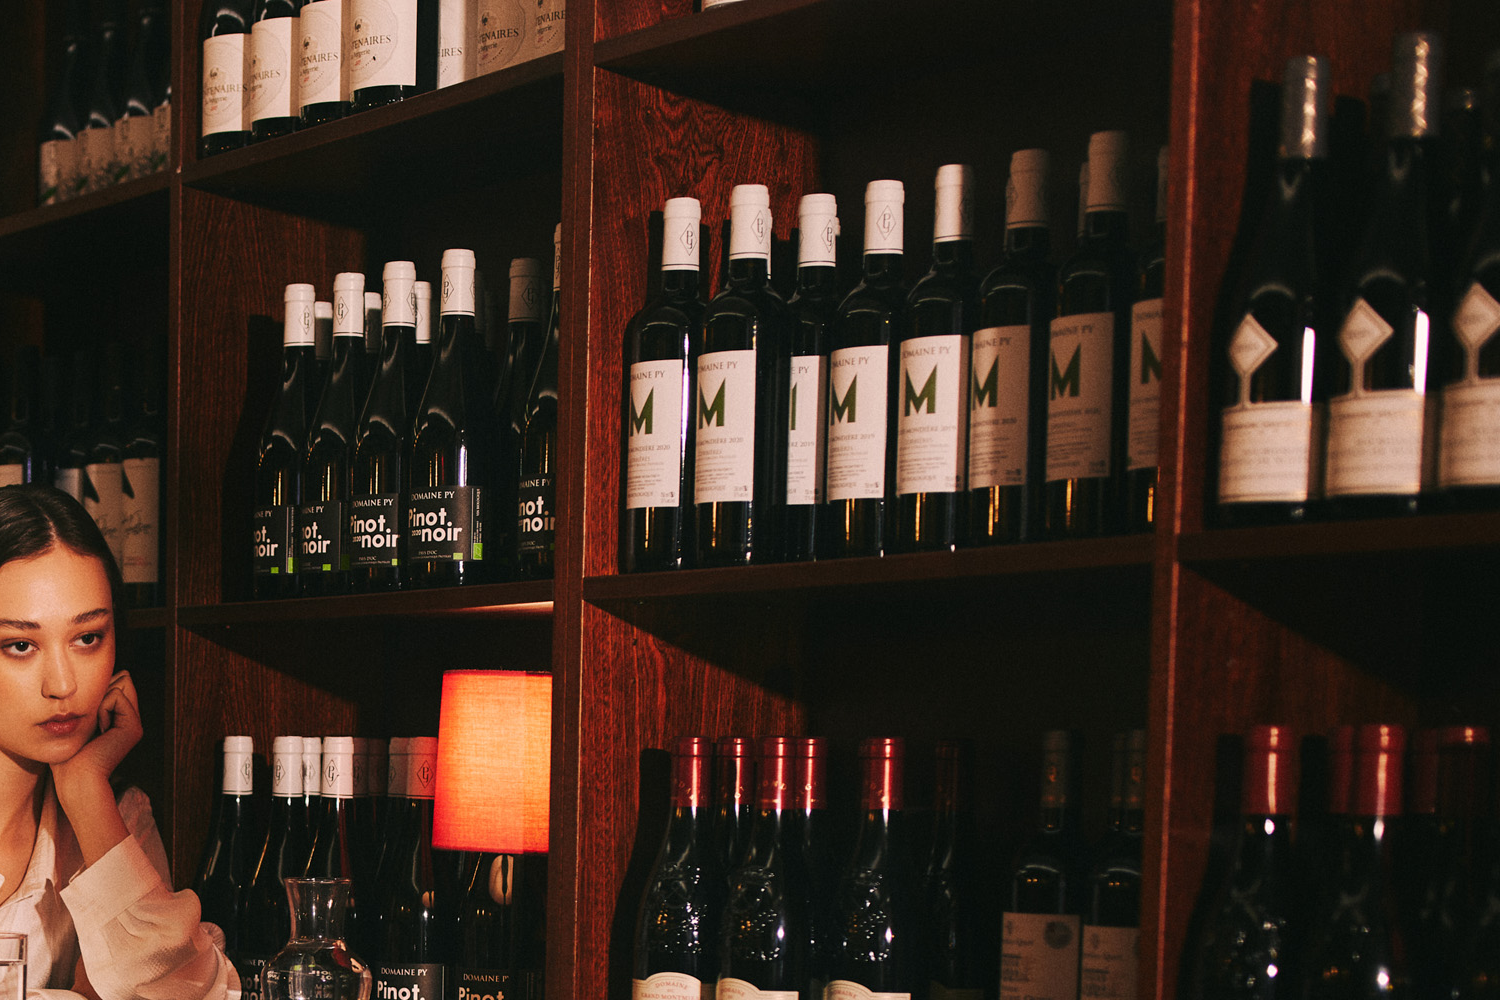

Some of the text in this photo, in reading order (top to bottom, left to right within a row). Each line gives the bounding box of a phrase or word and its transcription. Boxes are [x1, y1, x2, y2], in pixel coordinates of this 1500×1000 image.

[726, 361, 738, 370] PY
[798, 366, 810, 374] PY
[858, 356, 870, 365] PY
[654, 370, 666, 379] PY
[1050, 342, 1081, 401] M
[904, 364, 938, 417] M
[972, 354, 999, 412] M
[699, 377, 726, 430] M
[831, 373, 858, 426] M
[630, 386, 654, 437] M
[383, 498, 394, 507] PY
[444, 490, 455, 499] PY
[409, 507, 447, 528] Pinot
[361, 528, 400, 549] noir
[421, 521, 463, 542] noir
[381, 967, 428, 977] DOMAINE PY
[463, 973, 499, 983] DOMAINE
[377, 981, 420, 1000] Pinot
[655, 981, 688, 990] DOMAINE
